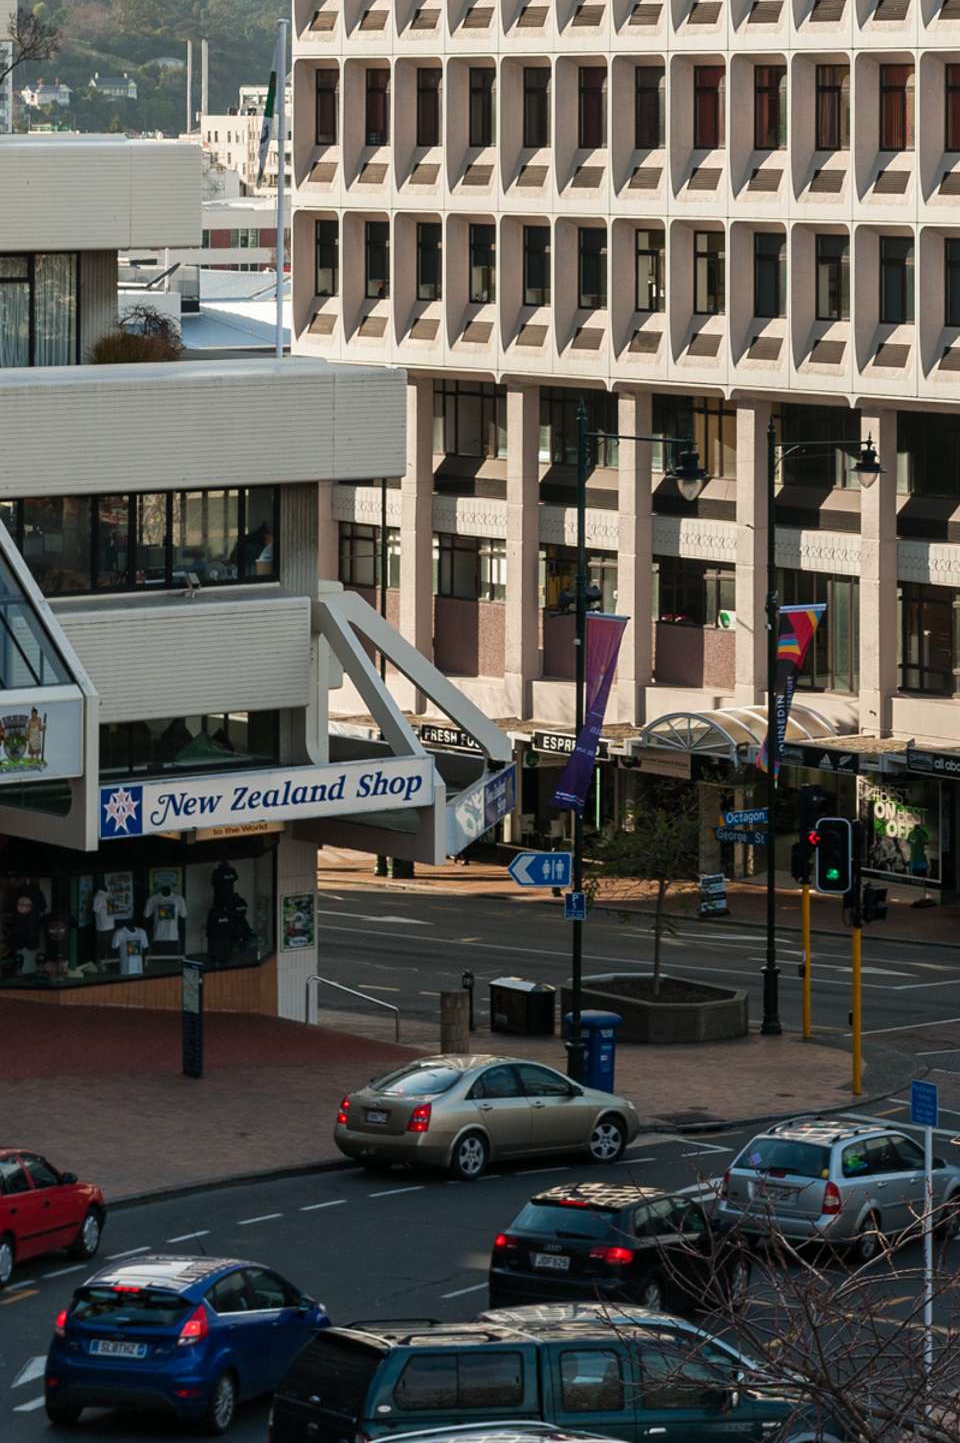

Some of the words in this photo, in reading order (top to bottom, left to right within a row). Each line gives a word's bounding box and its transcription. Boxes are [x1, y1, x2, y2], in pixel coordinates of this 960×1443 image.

[424, 728, 458, 743] FRESH
[460, 733, 481, 749] FO
[542, 735, 600, 756] ESPRO
[934, 758, 945, 769] all
[151, 793, 223, 826] New
[230, 774, 347, 811] Zealand
[356, 770, 422, 800] Shop
[725, 810, 765, 825] Octagon
[873, 801, 897, 819] ON
[224, 826, 240, 835] the
[241, 823, 268, 833] World
[716, 829, 748, 843] George
[754, 832, 765, 844] St
